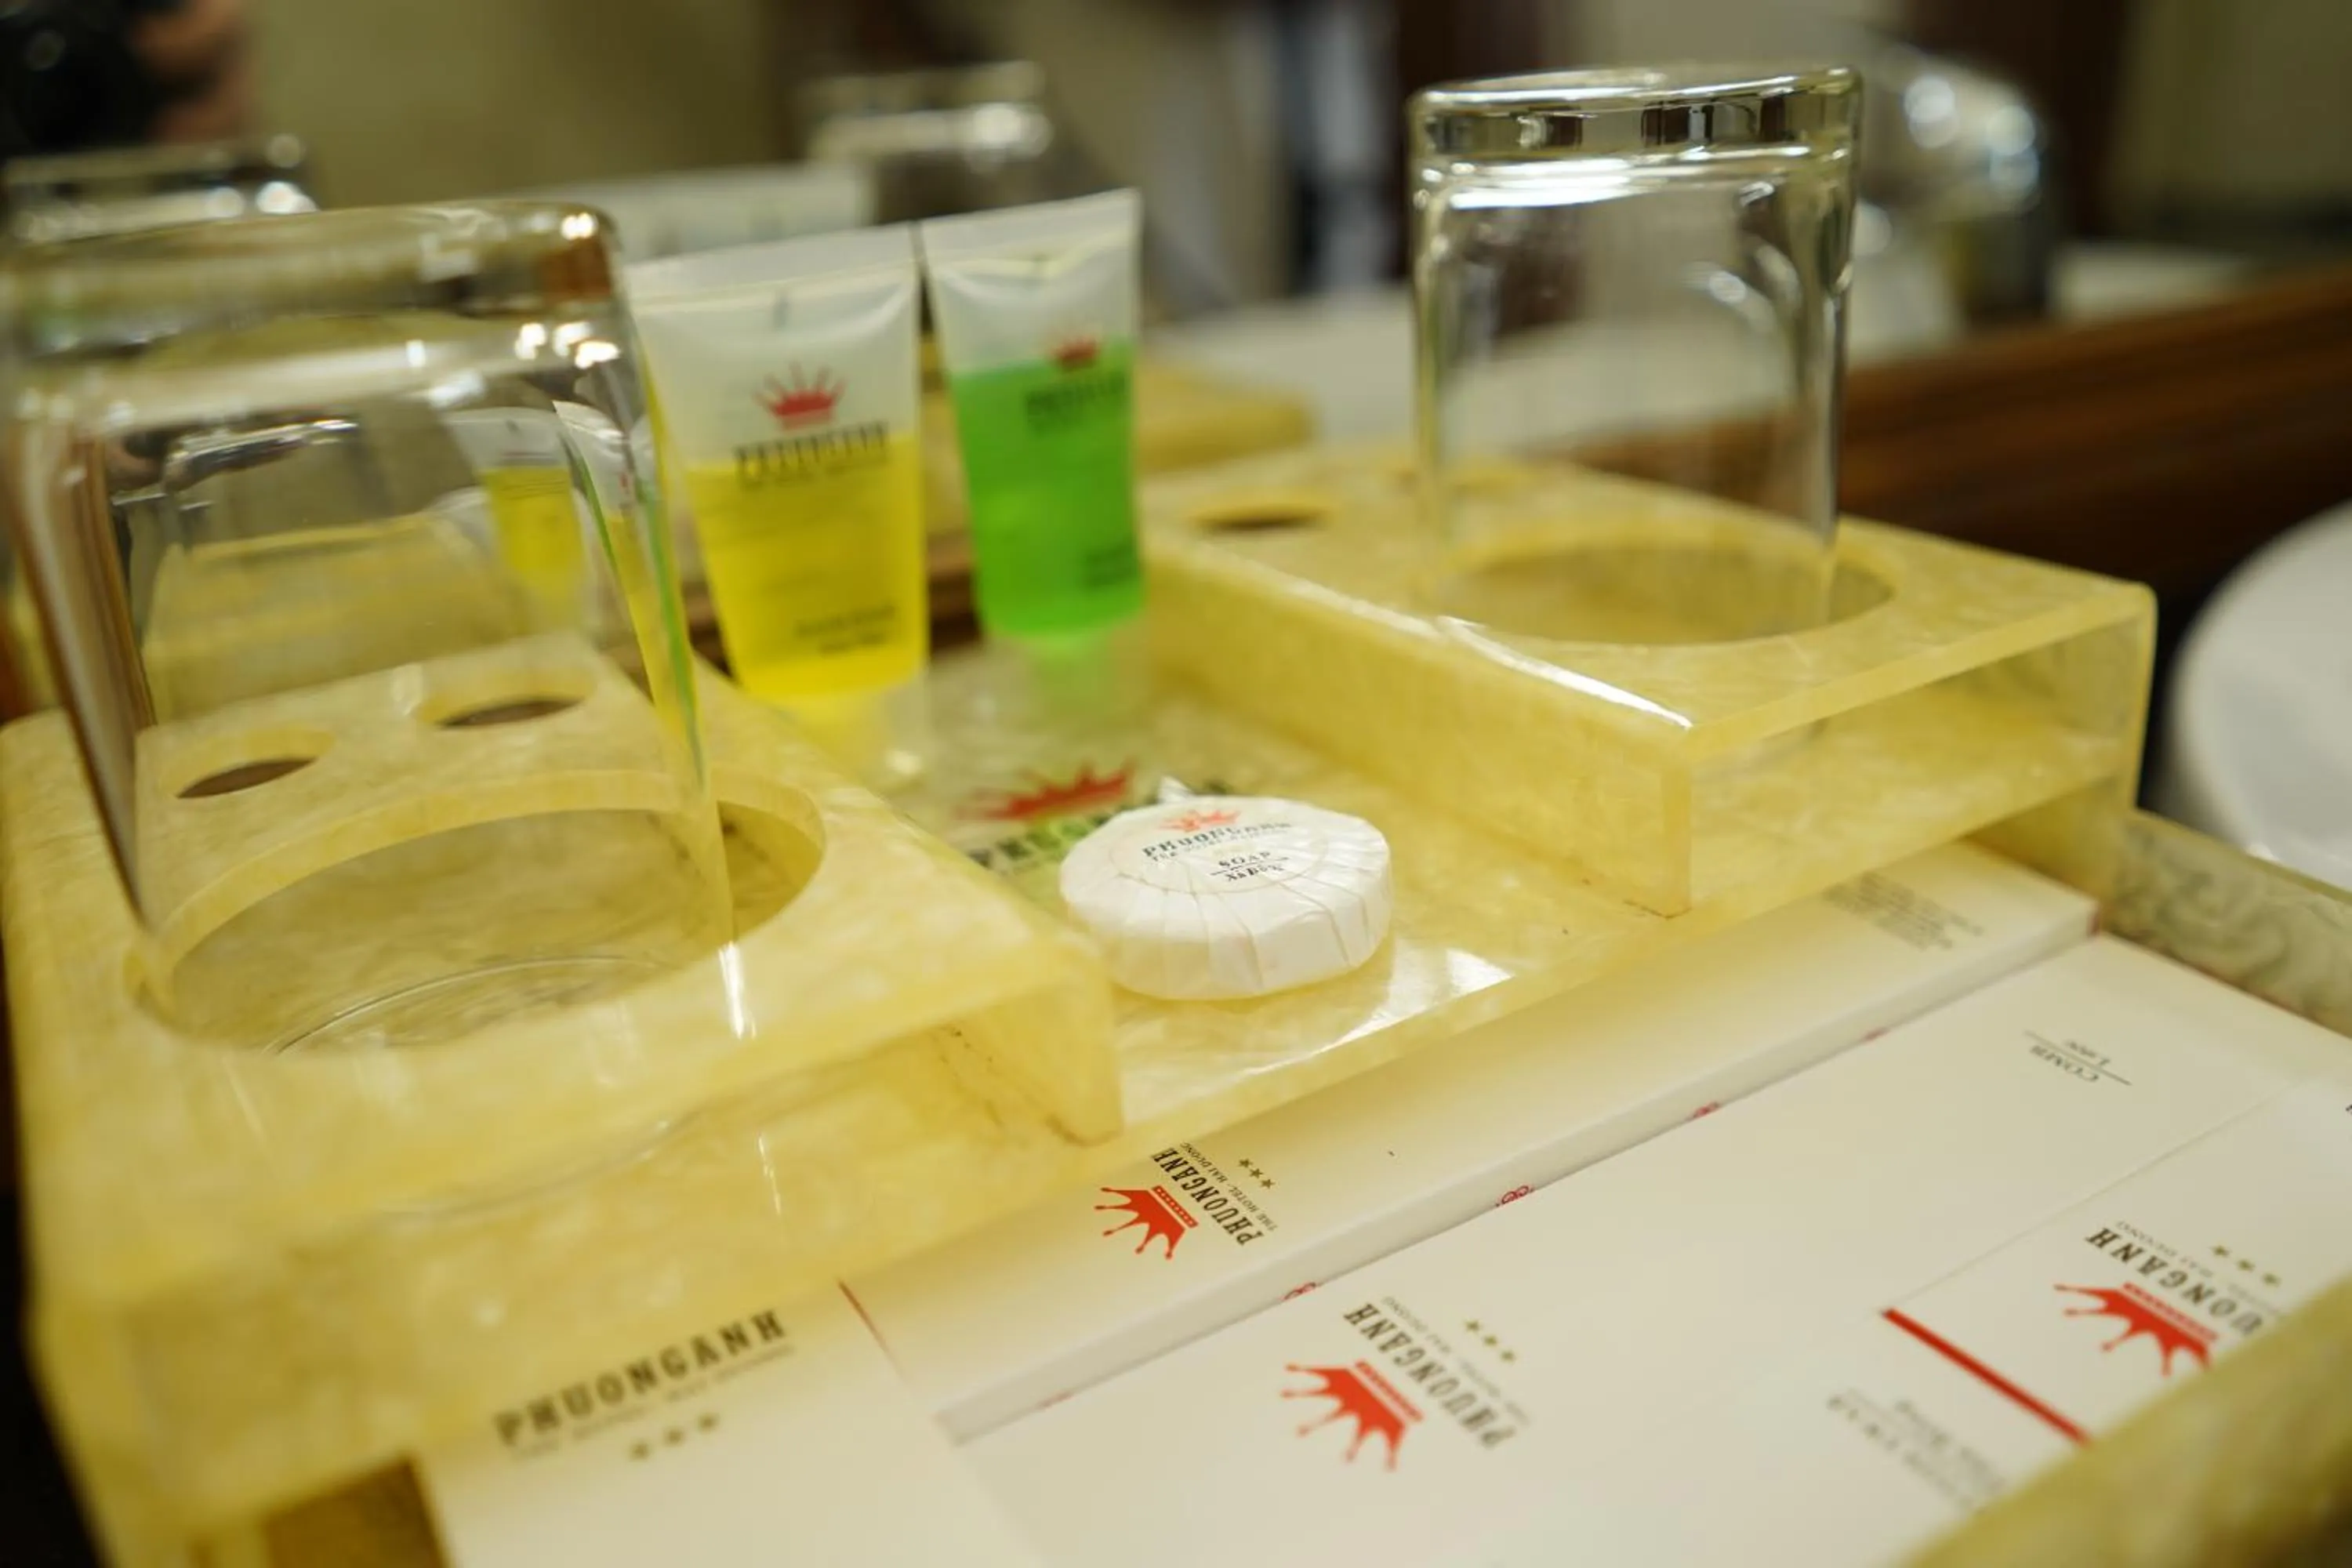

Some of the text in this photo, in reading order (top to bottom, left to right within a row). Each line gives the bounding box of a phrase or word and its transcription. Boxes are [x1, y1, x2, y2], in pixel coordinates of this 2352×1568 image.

[1219, 852, 1271, 866] SOAP
[2085, 1228, 2263, 1336] UONGANH
[494, 1309, 785, 1446] PHUONGANH
[1344, 1303, 1517, 1450] PHUONGANH
